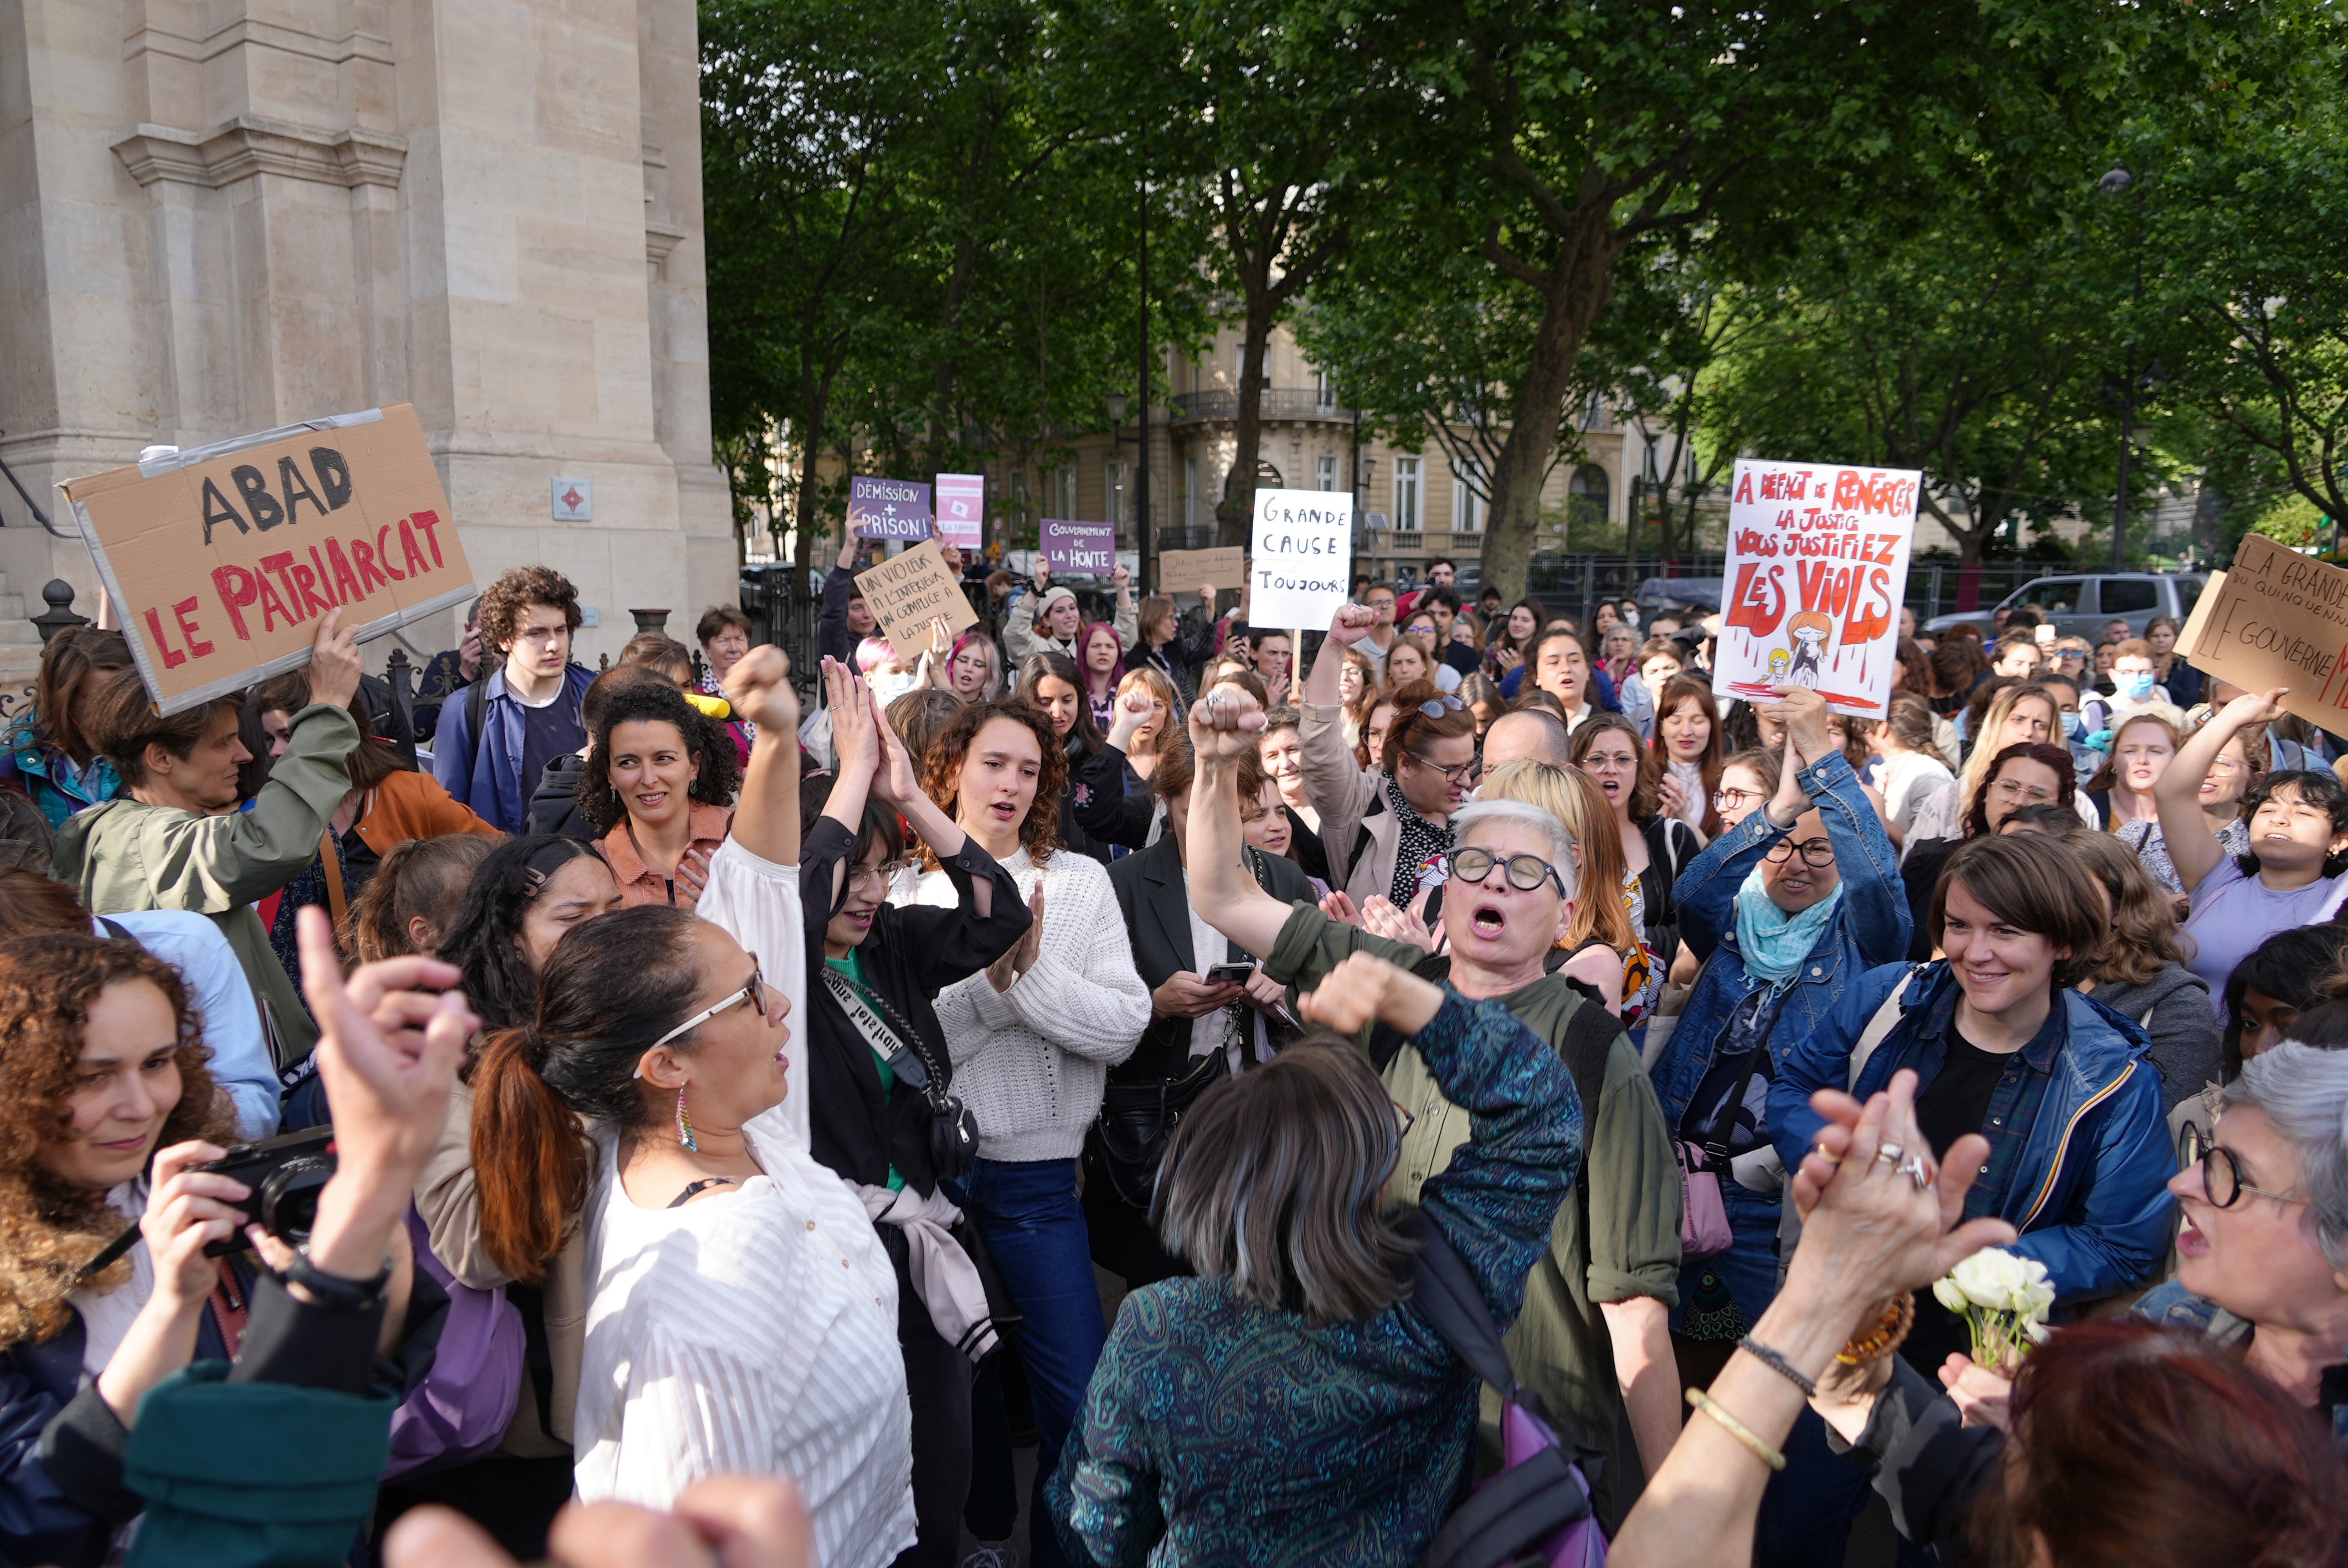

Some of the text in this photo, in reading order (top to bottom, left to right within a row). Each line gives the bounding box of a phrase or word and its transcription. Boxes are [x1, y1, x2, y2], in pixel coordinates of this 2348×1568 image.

[202, 446, 353, 546] ABAD
[1814, 482, 1827, 499] DE
[1831, 470, 1916, 518] RENFORCER
[1263, 496, 1347, 527] GRANDE
[1775, 510, 1795, 530] LA
[1049, 522, 1112, 537] GOUVERNEMENT
[1073, 538, 1085, 548] DE
[1735, 527, 1778, 558] VOUS
[1263, 533, 1337, 555] CAUSE
[1051, 549, 1109, 569] LA HONTE
[2239, 545, 2274, 577] LA
[142, 510, 445, 669] LE PATRIARCAT
[859, 574, 883, 593] UN
[1258, 571, 1346, 594] TOUJOURS
[1725, 562, 1786, 638] LES
[2233, 572, 2348, 627] DU QUINQUENN
[879, 611, 895, 631] UN
[899, 627, 915, 640] LA
[2197, 591, 2247, 661] LE
